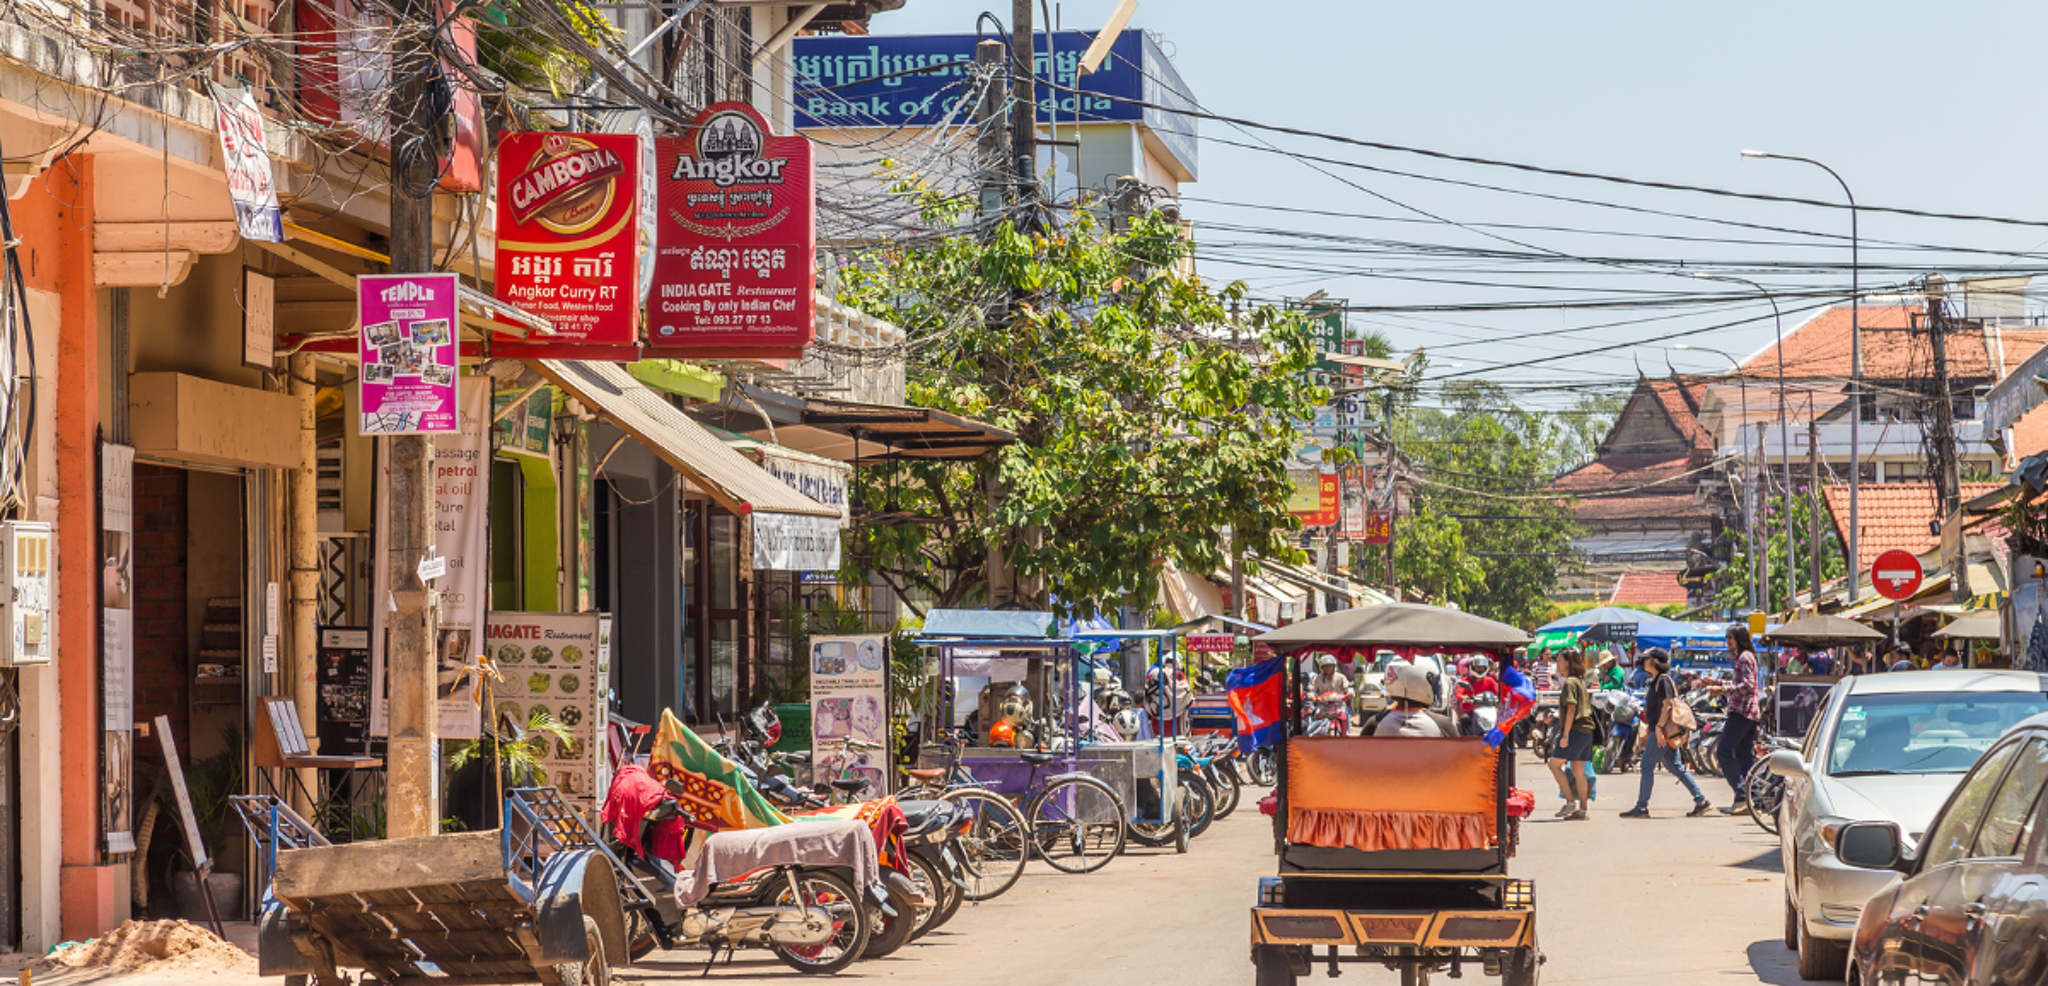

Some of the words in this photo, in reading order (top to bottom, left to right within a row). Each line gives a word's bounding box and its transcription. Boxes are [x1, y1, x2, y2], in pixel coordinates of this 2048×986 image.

[808, 97, 891, 116] Bank
[899, 95, 934, 115] of
[672, 152, 788, 187] Angkor
[511, 148, 620, 210] CAMBODIA
[380, 280, 435, 302] TEMPLE
[508, 283, 556, 301] Angkor
[559, 284, 597, 303] Curry
[600, 285, 618, 299] RT
[736, 285, 797, 297] Restaurant
[538, 301, 561, 311] Food,
[562, 302, 594, 311] Western
[595, 302, 614, 311] food
[661, 301, 701, 314] Cooking
[703, 300, 716, 314] By
[718, 300, 739, 314] only
[741, 299, 771, 312] Indian
[772, 299, 796, 312] Chef
[580, 314, 600, 324] shop
[694, 315, 711, 325] Tel:
[713, 315, 730, 325] 093
[732, 315, 743, 325] 27
[746, 315, 757, 325] 07
[759, 315, 771, 325] 13
[435, 449, 480, 462] assage
[438, 466, 479, 479] petrol
[450, 556, 464, 569] oil
[487, 623, 541, 639] IAGATE
[544, 629, 593, 641] Restaurant
